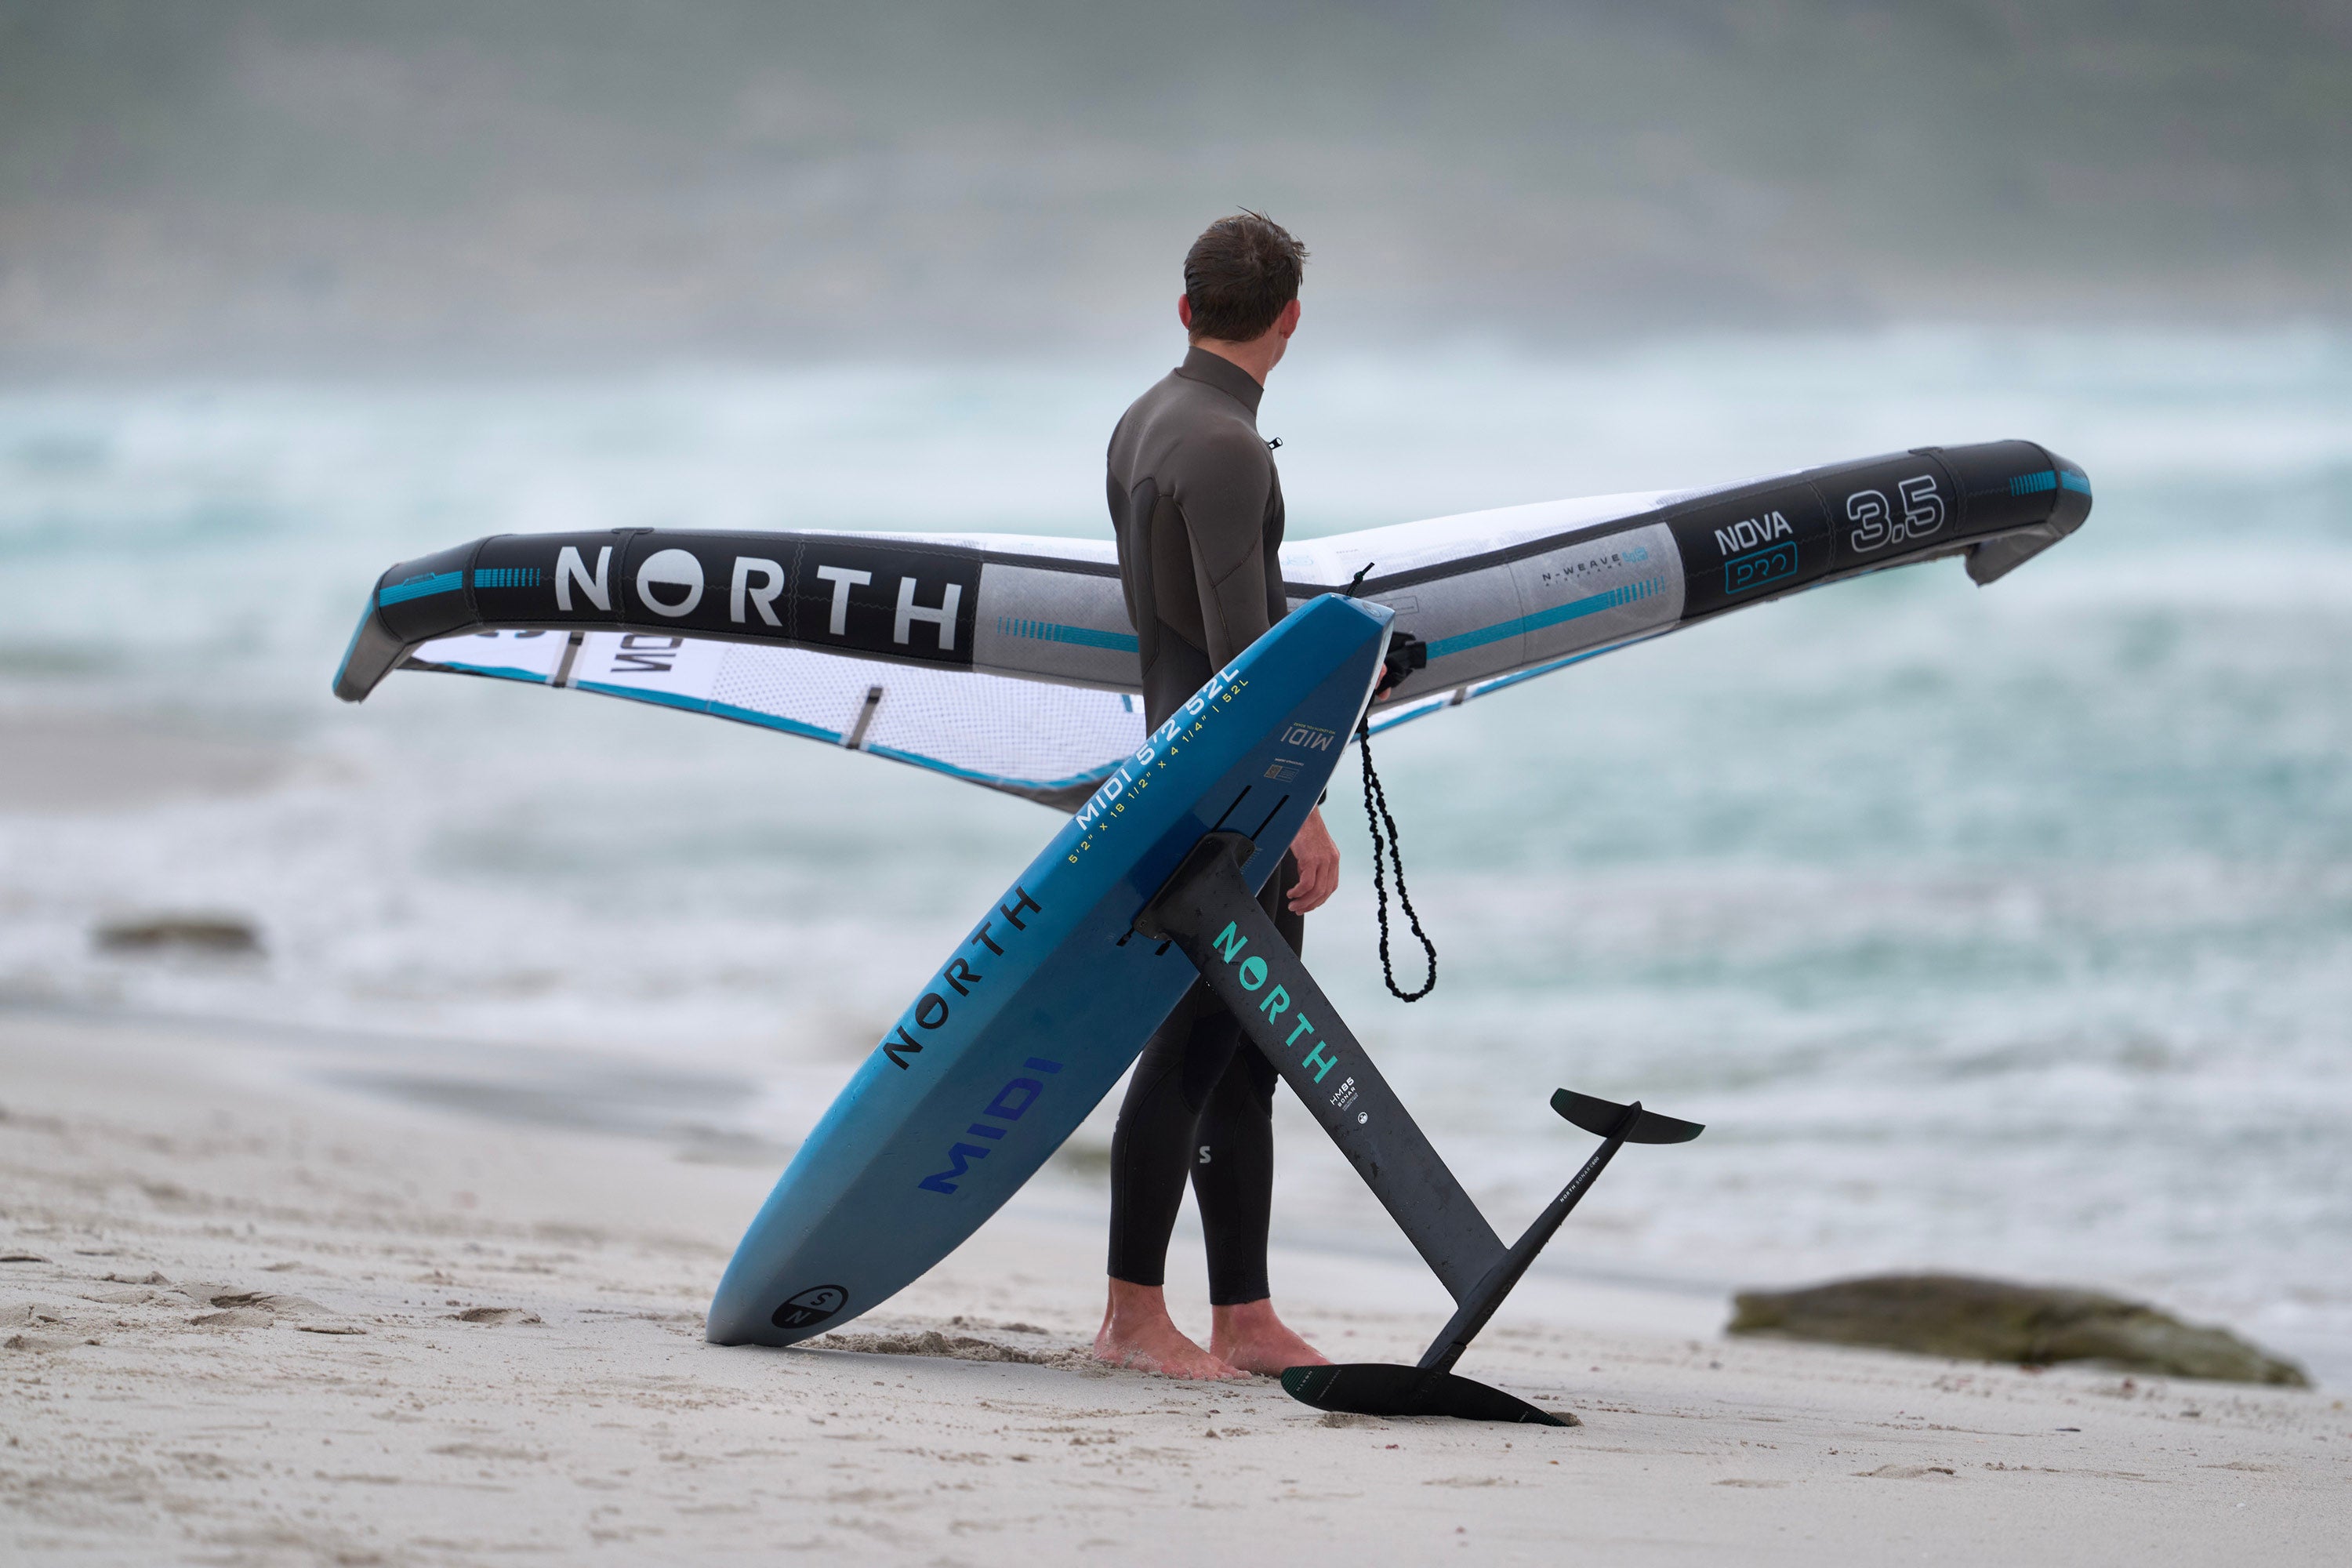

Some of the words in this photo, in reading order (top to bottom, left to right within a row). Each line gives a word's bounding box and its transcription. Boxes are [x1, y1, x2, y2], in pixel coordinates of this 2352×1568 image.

[1542, 554, 1620, 581] N-WEAVE
[1714, 510, 1793, 555] NOVA
[1737, 553, 1787, 585] PRO
[555, 546, 963, 651] NORTH
[1076, 768, 1132, 831] MIDI
[1136, 719, 1181, 765] 5'2
[1185, 669, 1240, 715] 52L
[1110, 803, 1125, 818] 18
[1171, 746, 1178, 755] 4
[1222, 680, 1248, 702] 52L
[1280, 726, 1334, 751] MIDI
[883, 886, 1043, 1070] NORTH
[1212, 920, 1338, 1084] NORTH
[918, 1057, 1064, 1195] MIDI
[1330, 1076, 1354, 1105] HM85
[1200, 1145, 1211, 1163] S
